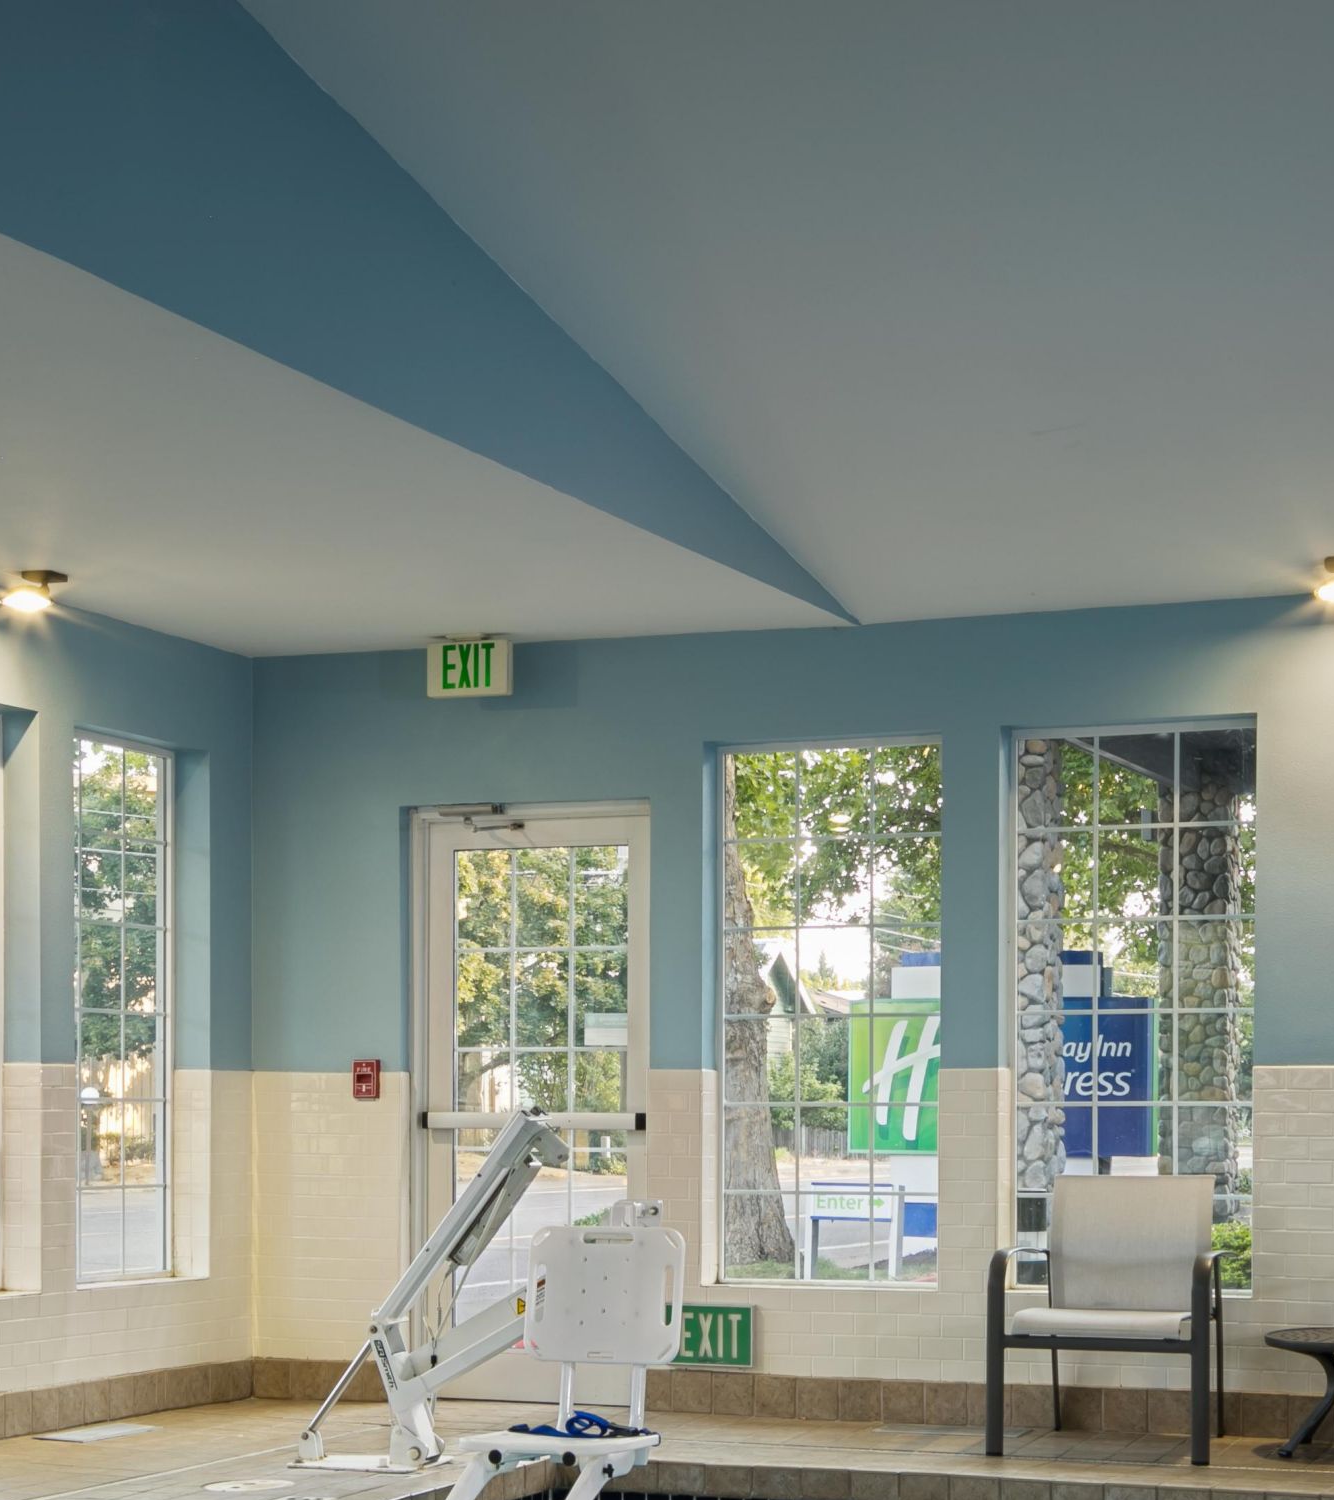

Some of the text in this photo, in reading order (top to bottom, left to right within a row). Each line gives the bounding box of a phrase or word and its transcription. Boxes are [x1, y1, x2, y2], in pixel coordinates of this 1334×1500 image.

[442, 642, 495, 689] EXIT
[1096, 1034, 1132, 1057] Inn
[1064, 1071, 1132, 1096] ress
[817, 1194, 864, 1210] Enter
[679, 1312, 742, 1359] EXIT
